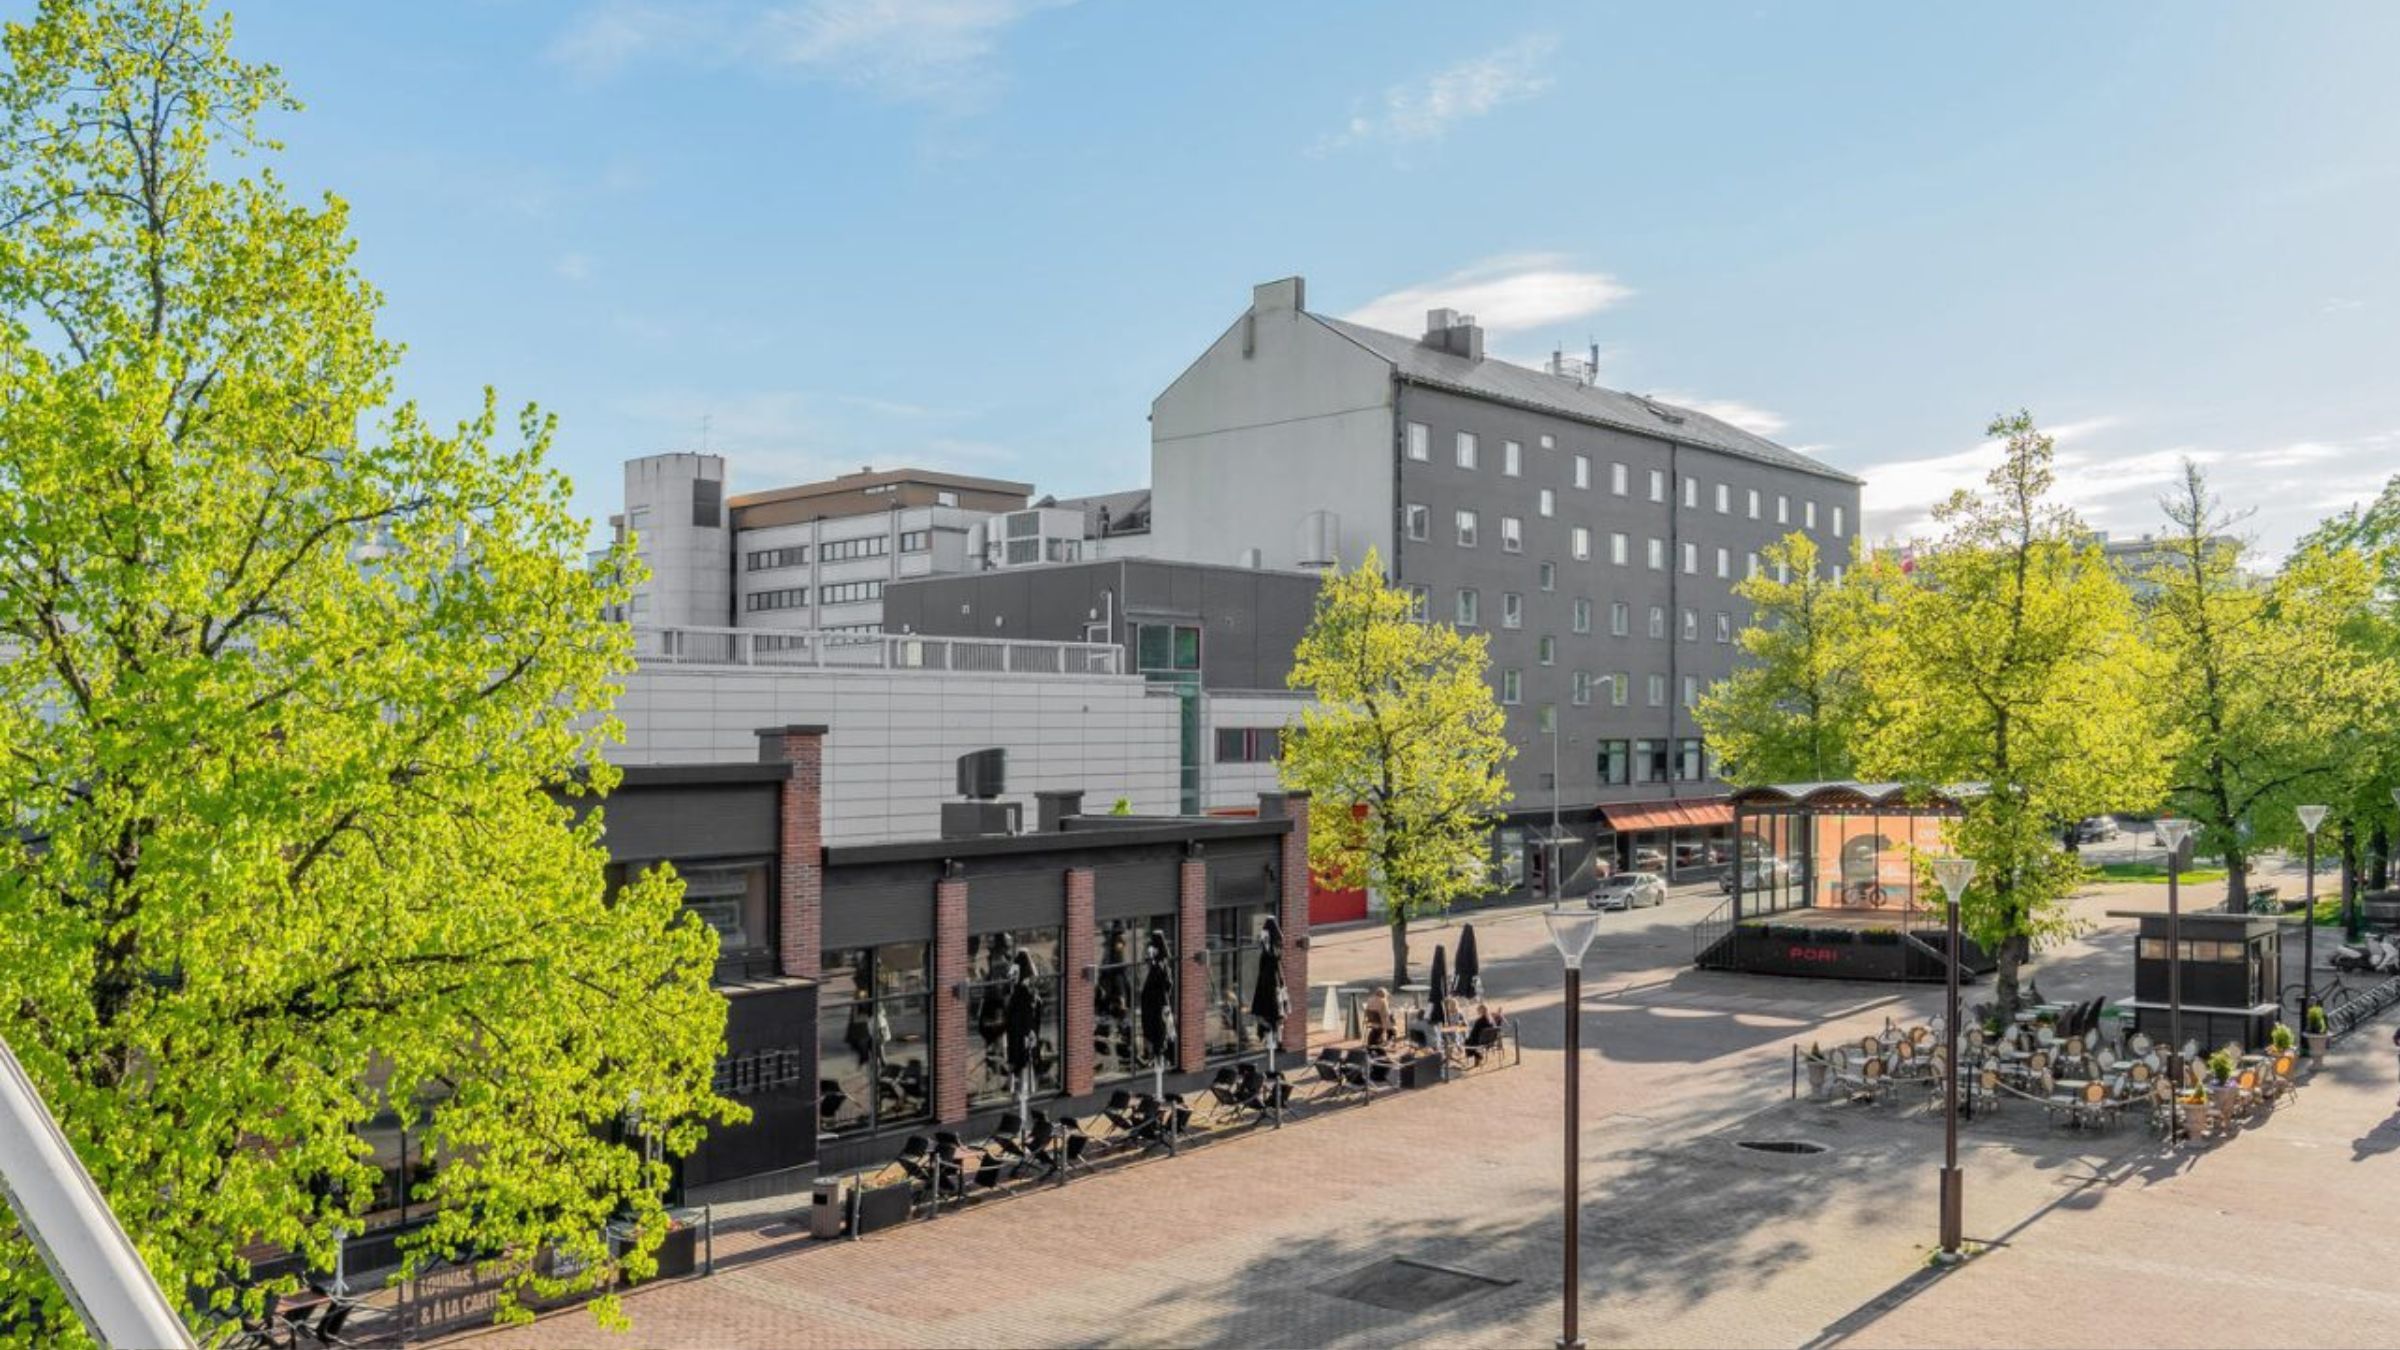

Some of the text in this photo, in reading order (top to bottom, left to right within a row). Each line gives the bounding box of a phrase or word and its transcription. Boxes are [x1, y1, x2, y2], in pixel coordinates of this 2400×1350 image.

[1789, 947, 1838, 962] PORI
[421, 1306, 431, 1326] &
[445, 1299, 460, 1318] LA
